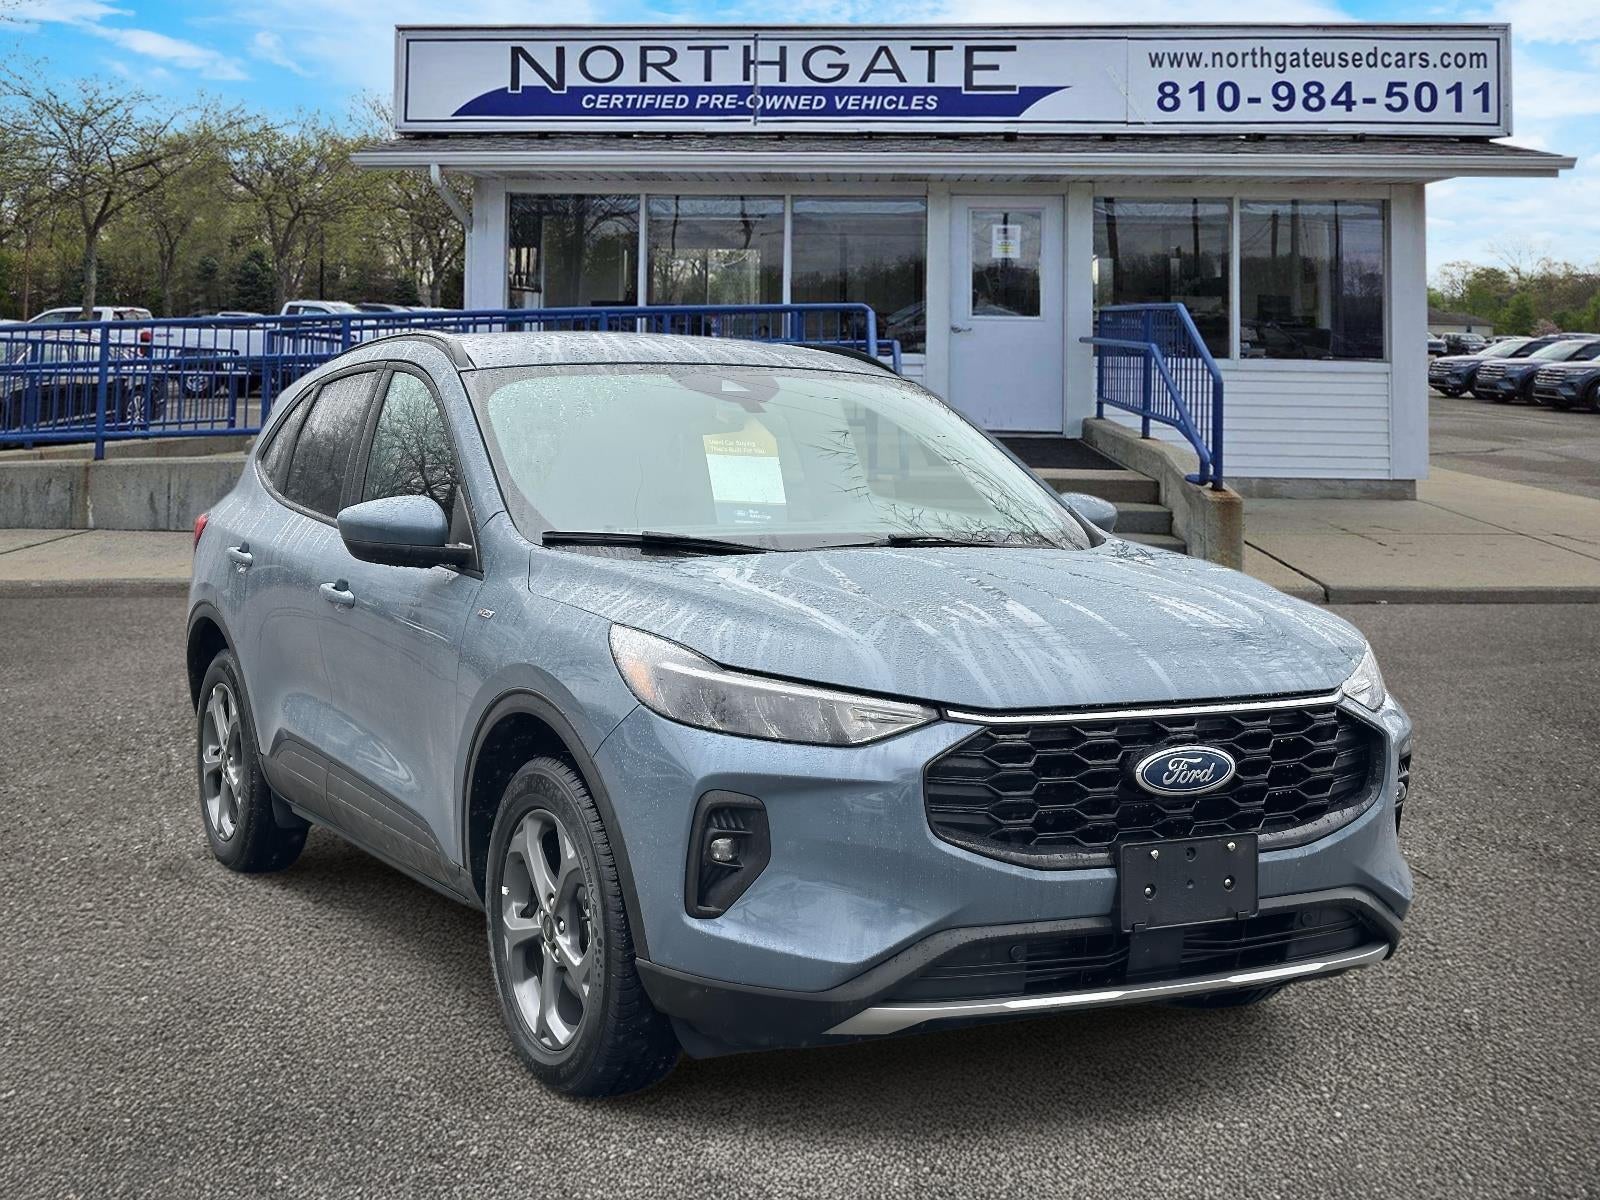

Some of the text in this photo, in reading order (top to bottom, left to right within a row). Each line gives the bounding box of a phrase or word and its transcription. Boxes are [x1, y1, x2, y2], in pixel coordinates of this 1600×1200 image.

[510, 45, 1018, 92] NORTHGATE
[1149, 46, 1488, 74] www.northgateusedcars.com
[581, 94, 939, 111] CERTIFIED PRE-OWNED VEHICLES
[1156, 80, 1491, 113] 810-984-5011
[1162, 757, 1216, 785] Ford
